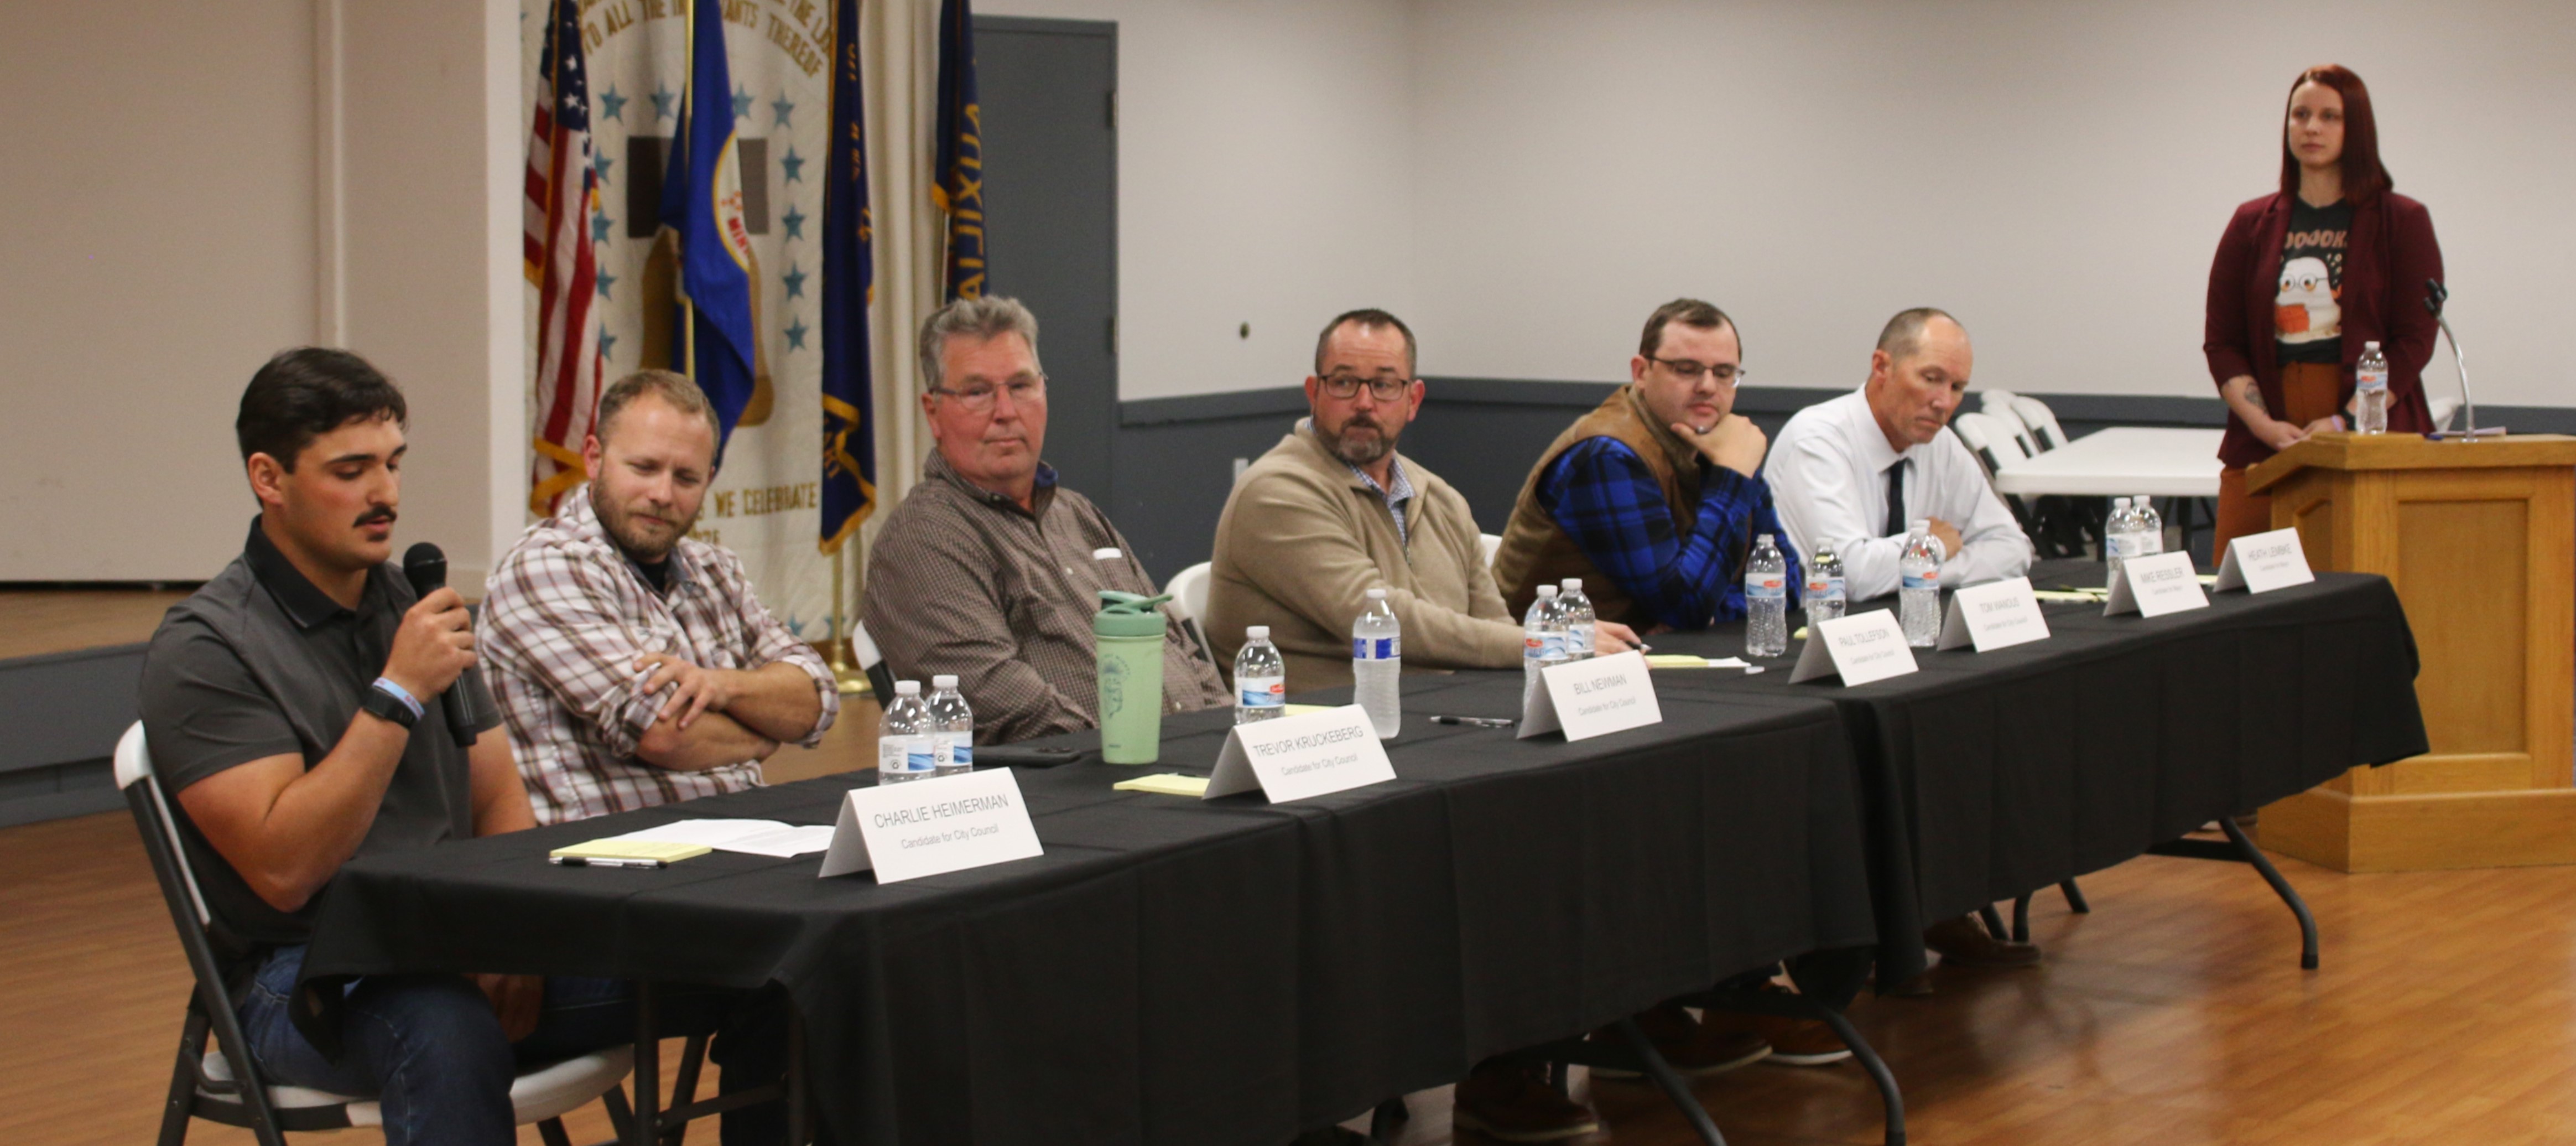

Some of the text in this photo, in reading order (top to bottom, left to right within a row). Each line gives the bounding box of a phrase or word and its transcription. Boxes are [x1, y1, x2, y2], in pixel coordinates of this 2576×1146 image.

[605, 1, 634, 37] ALL
[766, 11, 823, 78] THEREOF
[715, 490, 735, 517] WE
[743, 481, 817, 516] CELEBRATE
[1574, 673, 1627, 695] BILL NEWMAN
[1253, 725, 1364, 757] TREVOR KRUCKEBERG
[1281, 753, 1359, 776] Candidate for City Council
[874, 794, 1009, 828] CHARLIE HEIMERMAN
[901, 823, 999, 849] Candidate for City Council
